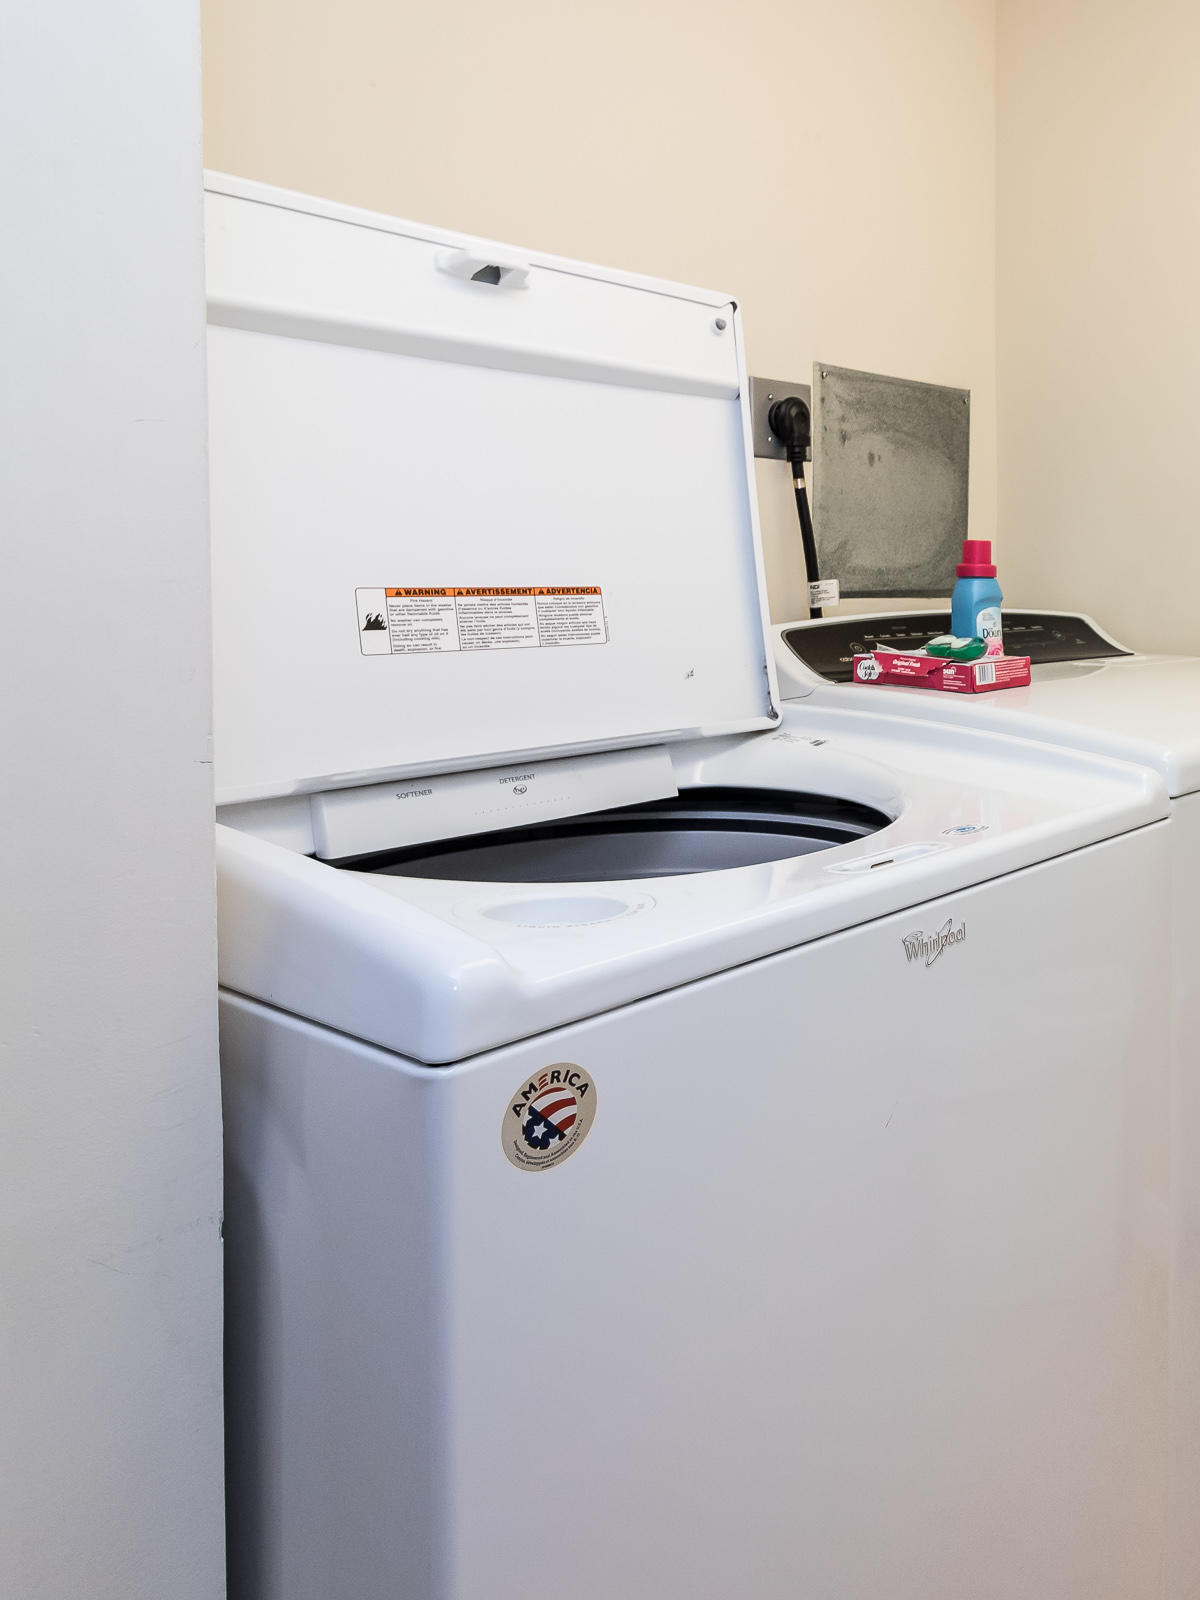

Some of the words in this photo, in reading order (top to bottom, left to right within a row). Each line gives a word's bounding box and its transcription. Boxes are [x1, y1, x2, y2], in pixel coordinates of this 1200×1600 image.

[404, 588, 447, 596] WARNING
[466, 587, 532, 595] AVERTISSEMENT
[546, 587, 598, 595] ADVERTENCIA
[499, 773, 536, 785] DETERGENT
[396, 788, 433, 800] SOFTENER
[902, 919, 966, 967] Whirlpool
[512, 1069, 590, 1119] AMERICA
